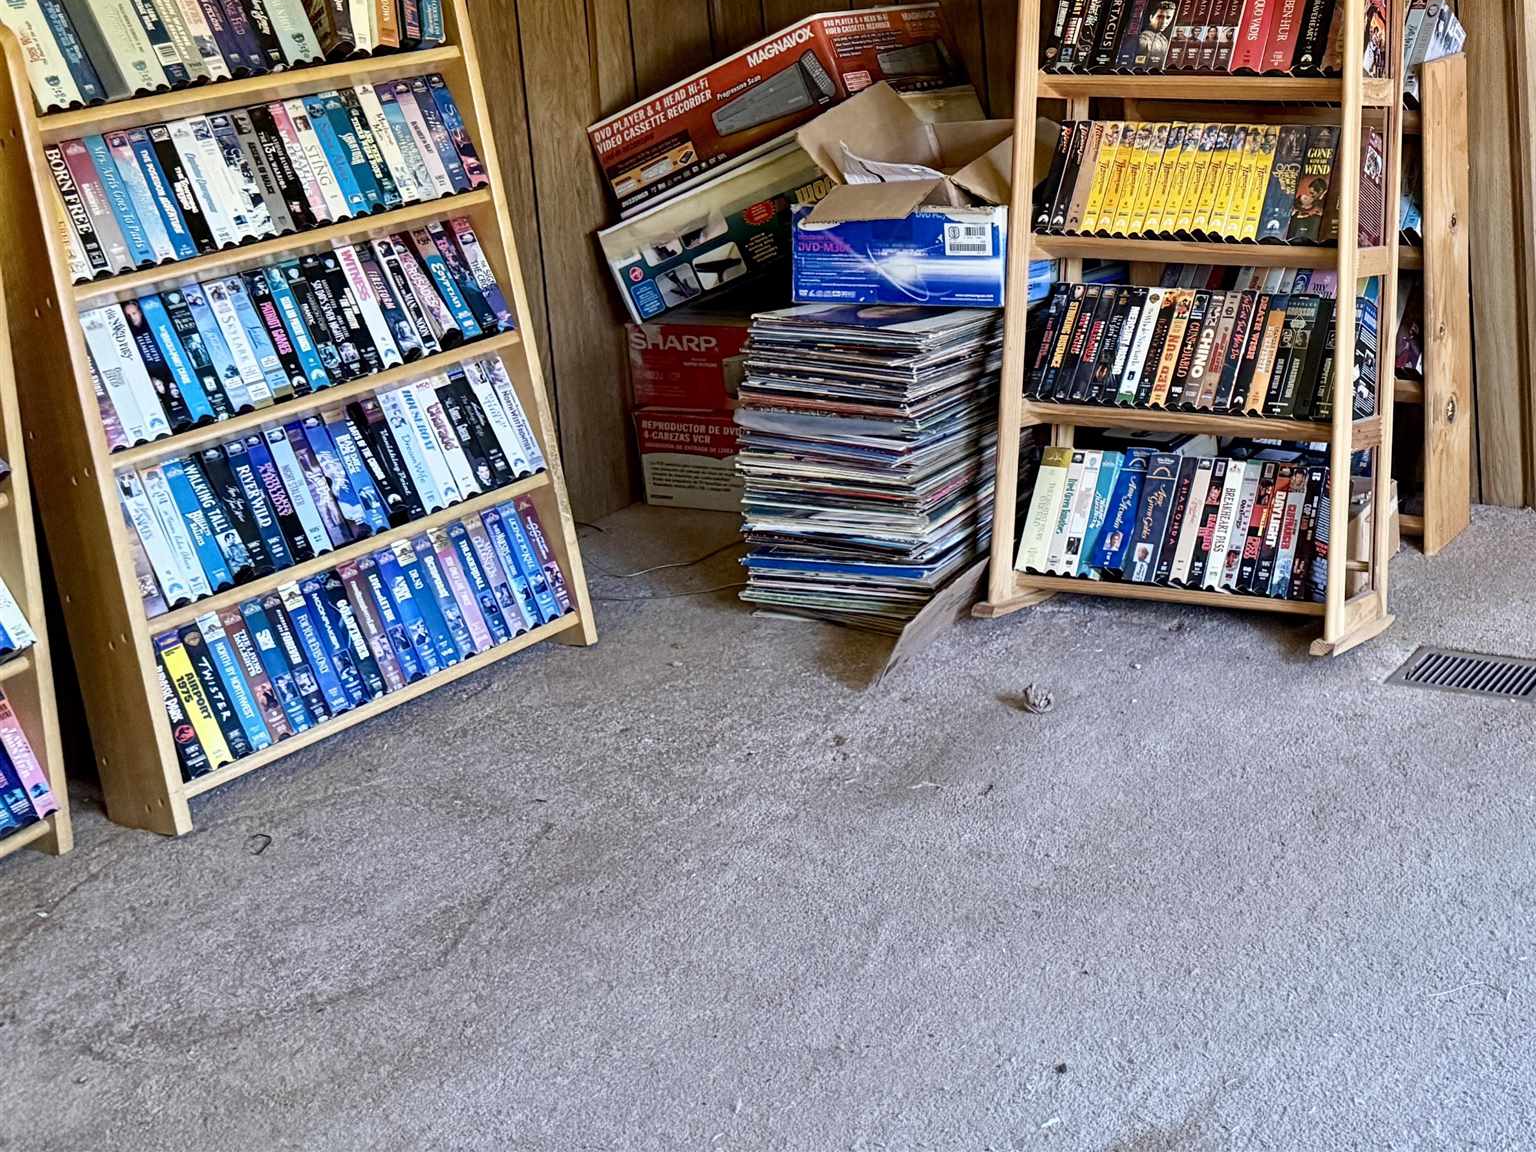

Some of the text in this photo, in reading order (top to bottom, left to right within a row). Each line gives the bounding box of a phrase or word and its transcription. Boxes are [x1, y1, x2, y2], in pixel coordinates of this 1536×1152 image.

[747, 26, 814, 68] MAGNAVOX
[1246, 16, 1261, 41] VADIS
[716, 75, 762, 100] Progressive Scan
[595, 77, 709, 144] DVD PLAYER & 4 HEAD Hi-Fi
[596, 89, 712, 154] VIDEO CASSETTE RECORDER
[139, 148, 151, 163] THE
[304, 143, 332, 187] STING
[1304, 164, 1331, 176] WIND
[1307, 148, 1333, 160] GONE
[44, 145, 92, 236] BORN FREE
[112, 188, 129, 211] Goes
[127, 222, 145, 248] Paris
[340, 248, 370, 302] WITNESS
[470, 259, 482, 275] THE
[367, 269, 395, 311] FIRESTORM
[259, 300, 292, 356] PATRIOT GAMES
[404, 292, 429, 337] MAN NOON
[1049, 299, 1079, 368] STRIKING DISTANCE
[1246, 295, 1268, 360] DEATH WISH
[630, 334, 716, 351] SHARP
[1155, 333, 1176, 392] RED SUN
[1176, 346, 1193, 378] DIABLO
[1190, 327, 1214, 379] CHINO
[400, 387, 435, 451] HOUSEBOAT
[642, 420, 720, 435] REPRODUCTOR DE
[693, 434, 710, 444] VCR
[182, 463, 229, 533] WALKING TALL
[235, 463, 261, 500] RIVER
[249, 496, 273, 528] WILD
[262, 473, 287, 517] HOLIDAY
[1061, 491, 1072, 508] Green
[1167, 478, 1189, 545] ANACONDA
[1212, 486, 1236, 553] BREAKHEART PASS
[1263, 489, 1288, 547] DAYLIGHT
[279, 629, 302, 665] FOREVER
[335, 597, 370, 660] GOLDFINGER
[214, 641, 232, 667] NORTH
[225, 665, 236, 677] BY
[164, 697, 185, 724] PARK
[175, 675, 193, 704] 1975
[184, 671, 212, 721] AIRPORT
[196, 655, 233, 722] TWISTER
